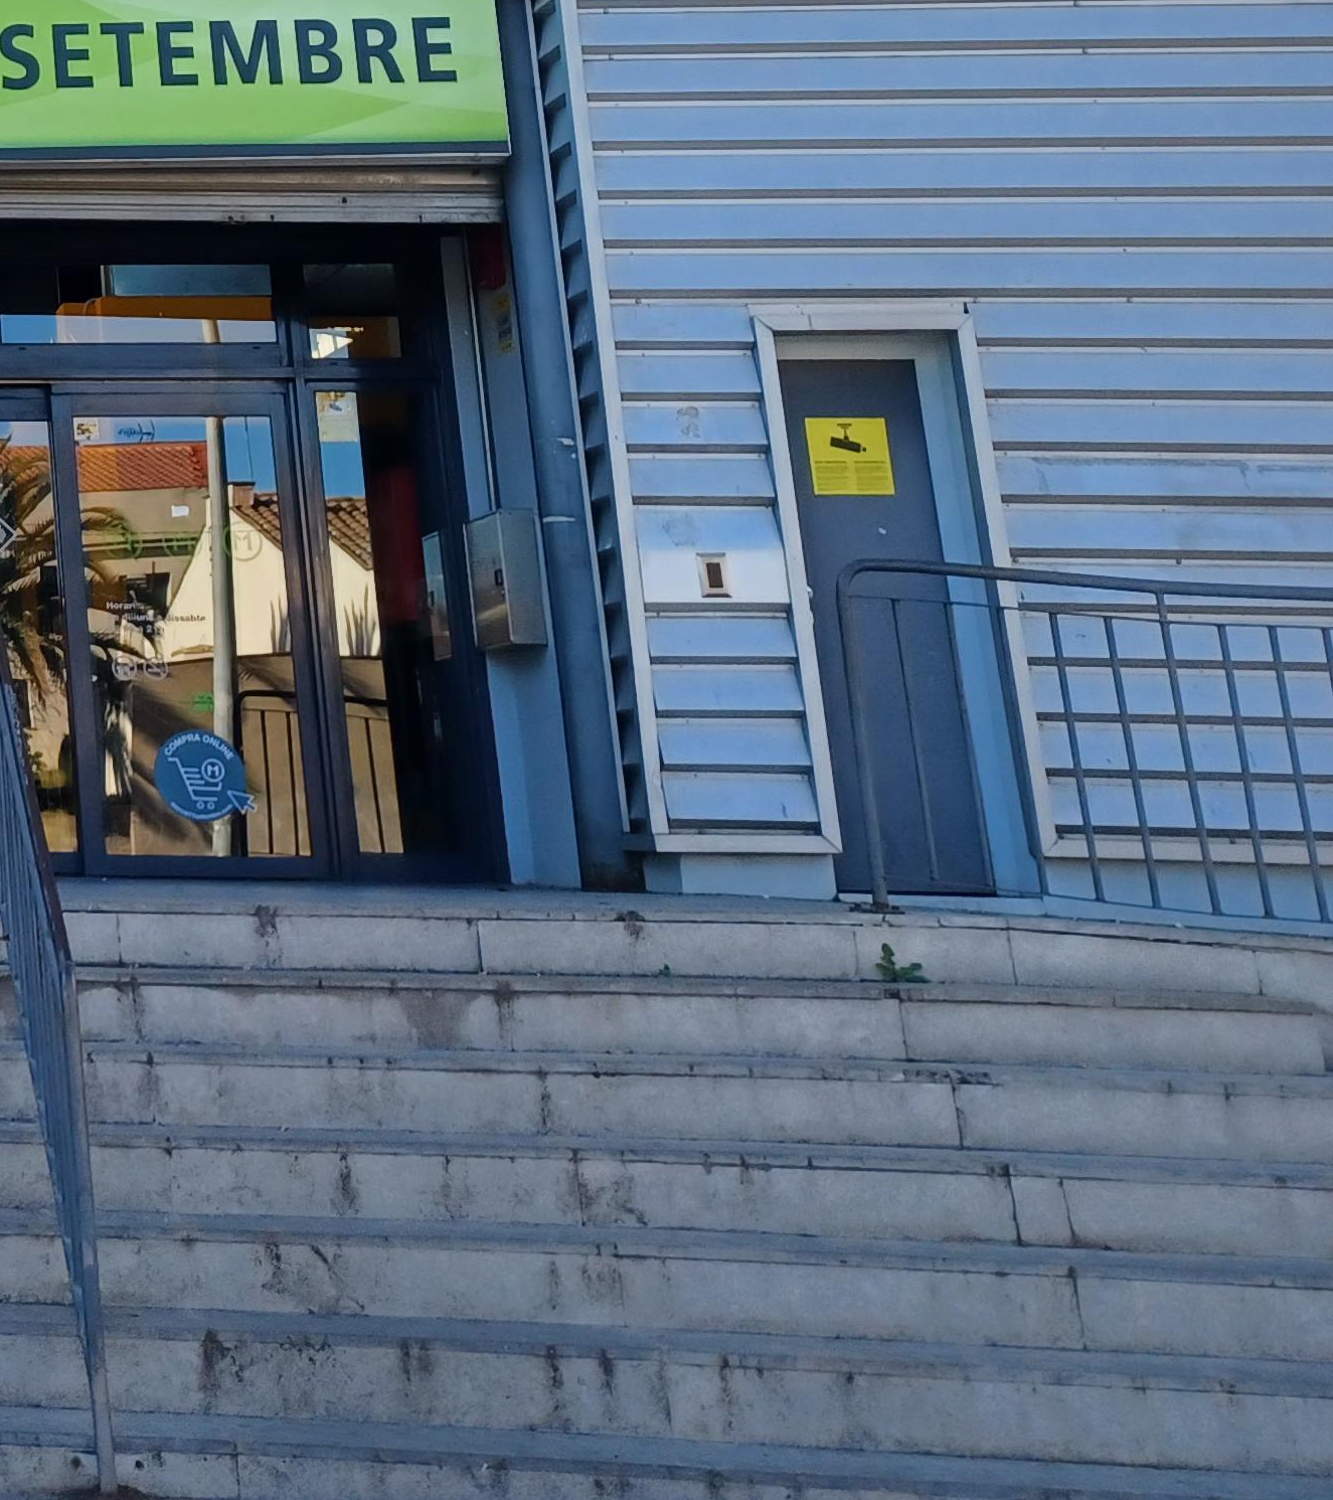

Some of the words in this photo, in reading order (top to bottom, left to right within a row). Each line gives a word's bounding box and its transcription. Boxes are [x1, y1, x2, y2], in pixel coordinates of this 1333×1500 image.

[0, 17, 458, 90] SETEMBRE
[164, 733, 201, 756] COMPRA
[202, 735, 235, 761] ONLINE
